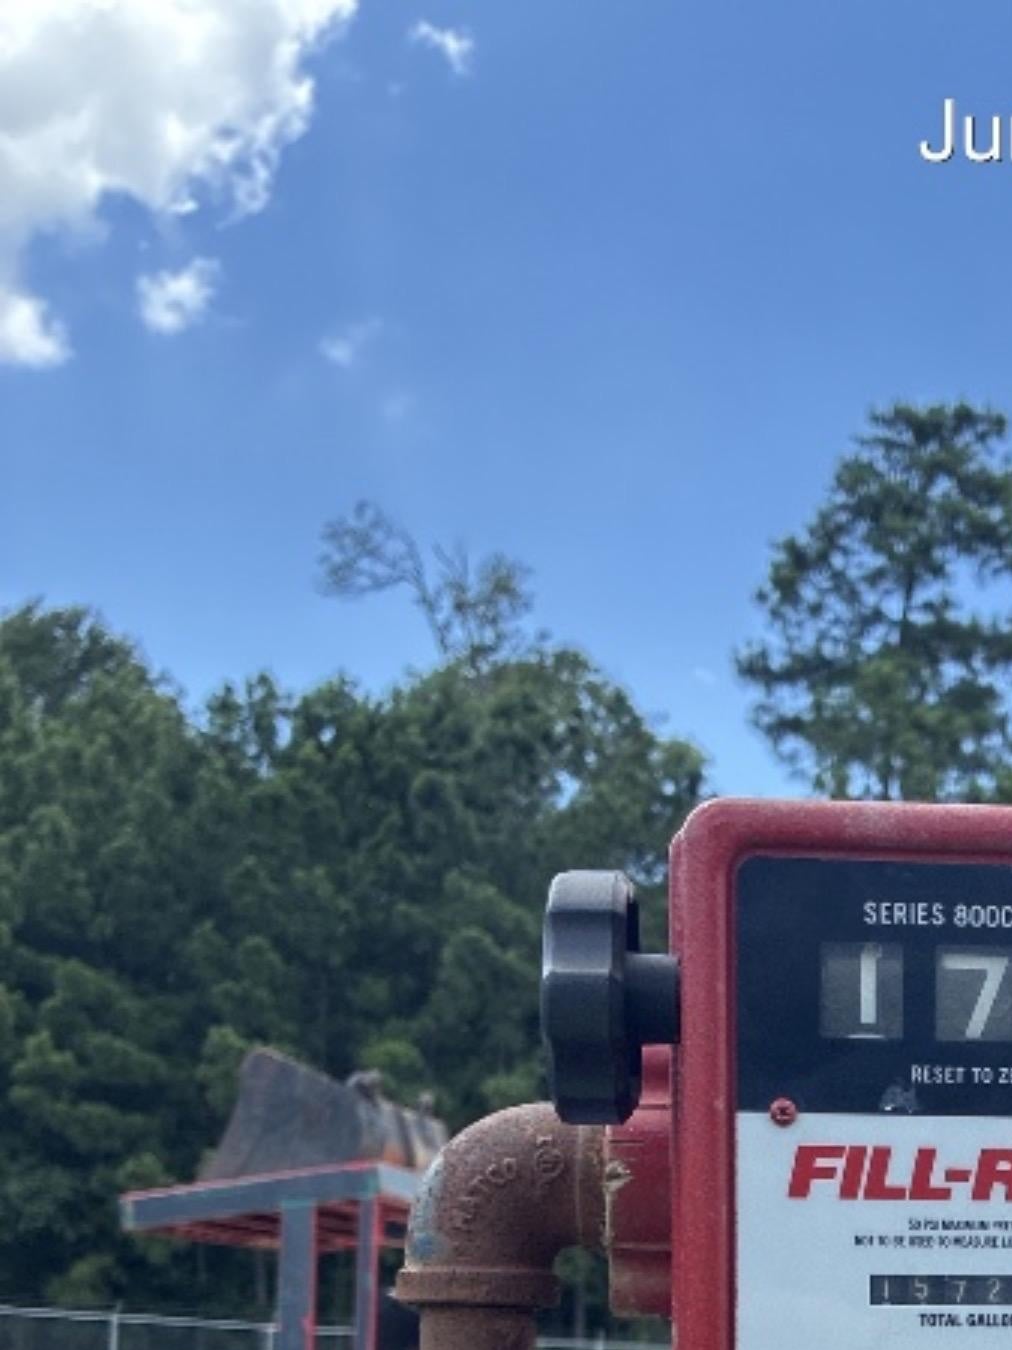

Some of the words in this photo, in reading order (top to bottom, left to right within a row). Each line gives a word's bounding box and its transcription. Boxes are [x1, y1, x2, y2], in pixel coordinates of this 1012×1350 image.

[863, 902, 945, 926] SERIES
[942, 954, 1011, 1039] 7
[911, 1064, 964, 1084] RESET
[972, 1065, 993, 1084] TO
[919, 1313, 963, 1328] TOTAL
